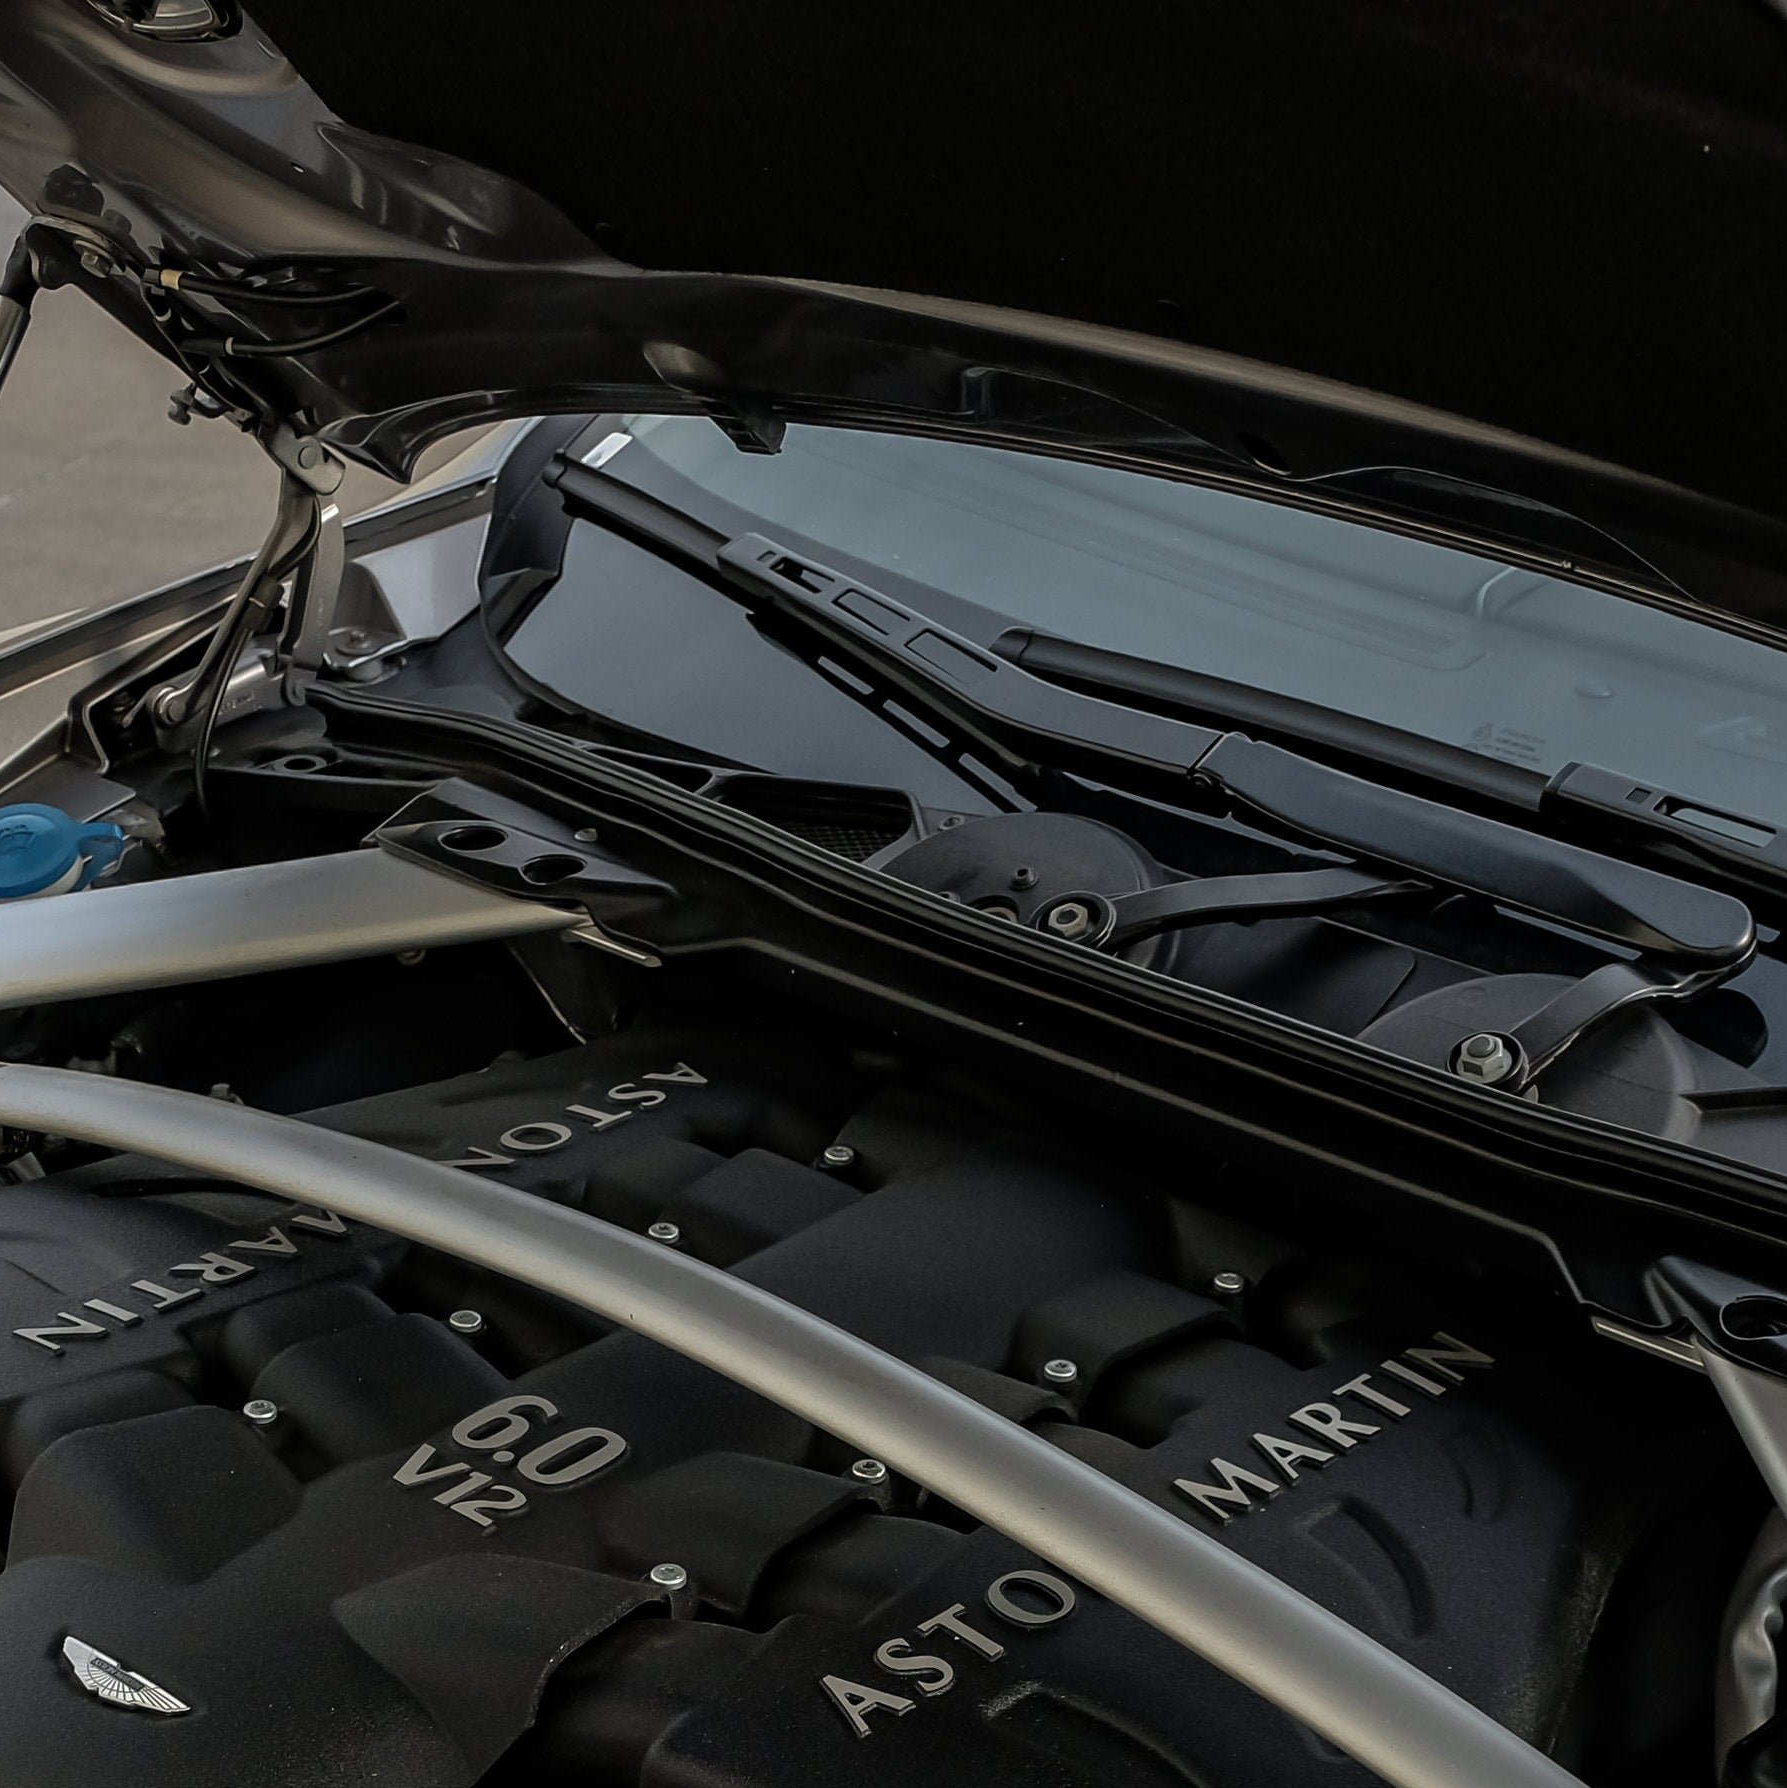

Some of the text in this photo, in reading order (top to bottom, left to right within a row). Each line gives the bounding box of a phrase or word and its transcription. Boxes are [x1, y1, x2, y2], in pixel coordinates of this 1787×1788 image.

[433, 1061, 709, 1169] ASTON
[392, 1443, 530, 1528] V12
[452, 1394, 629, 1487] 6.0
[821, 1331, 1496, 1740] ASTO MARTIN
